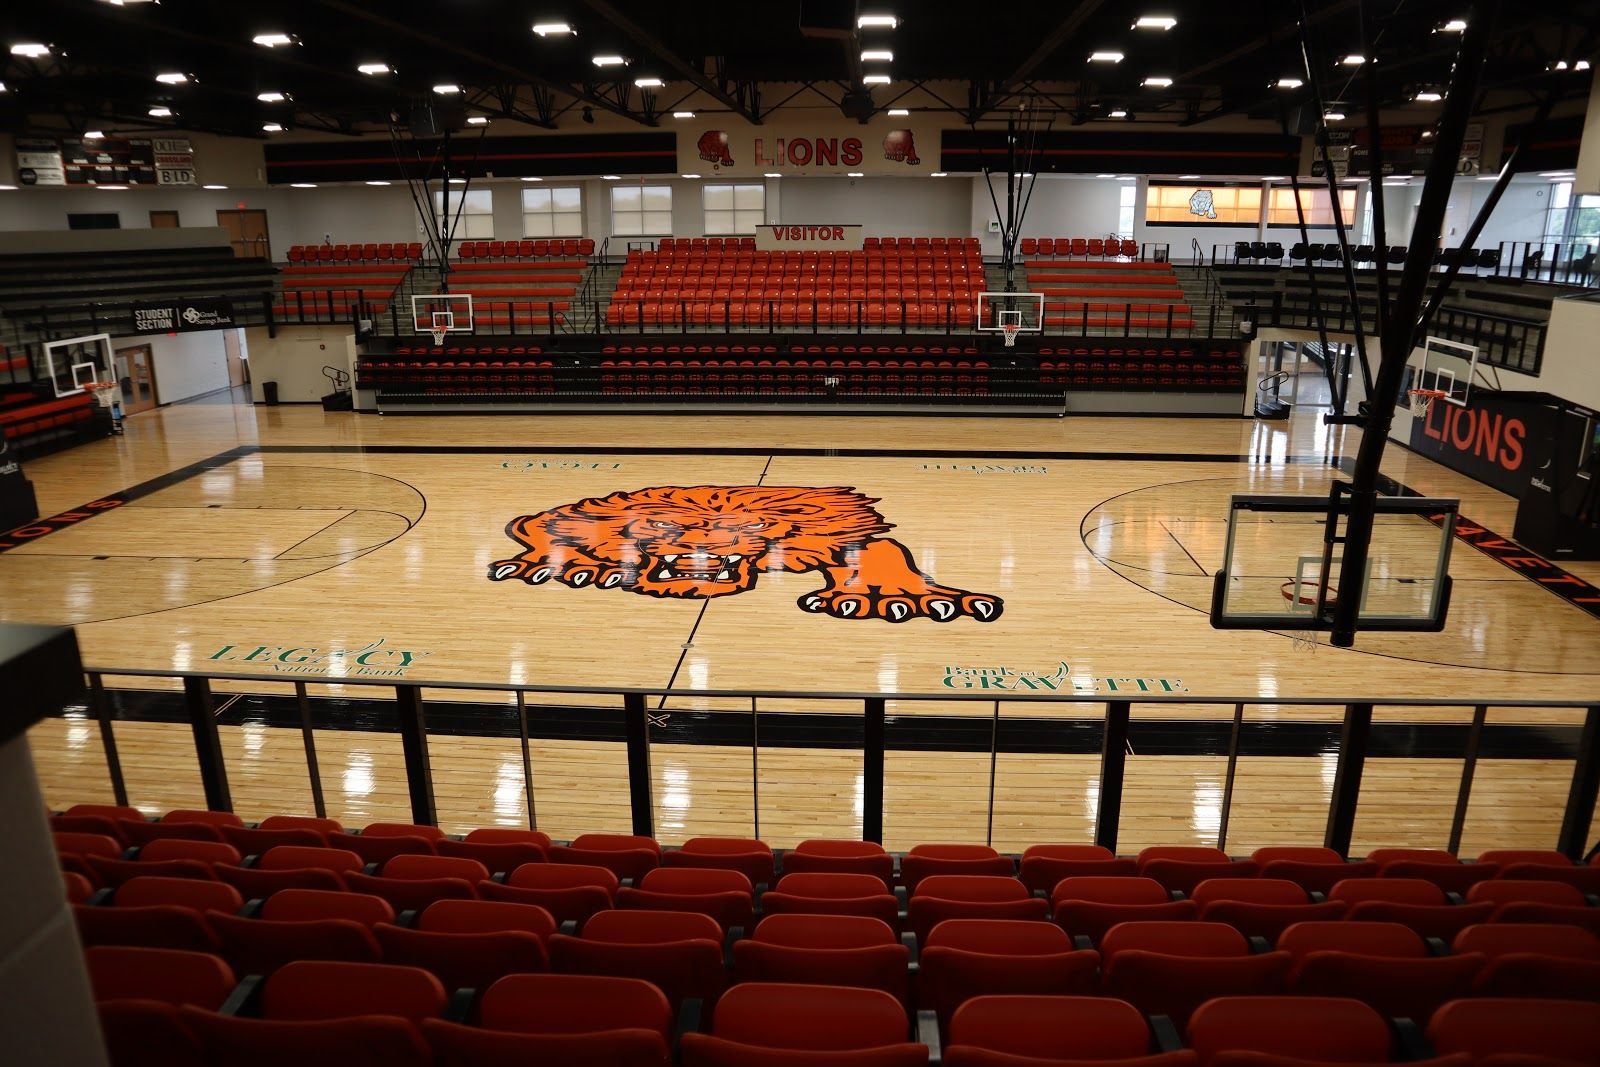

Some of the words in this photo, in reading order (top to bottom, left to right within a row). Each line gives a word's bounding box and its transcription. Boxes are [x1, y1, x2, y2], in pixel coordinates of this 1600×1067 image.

[754, 137, 863, 166] LIONS
[772, 225, 845, 241] VISITOR
[134, 308, 174, 320] STUDENT
[136, 319, 173, 330] SECTION
[1424, 399, 1526, 471] LIONS
[271, 664, 353, 674] Nationl
[356, 667, 406, 677] Bank
[944, 666, 1015, 676] Bank
